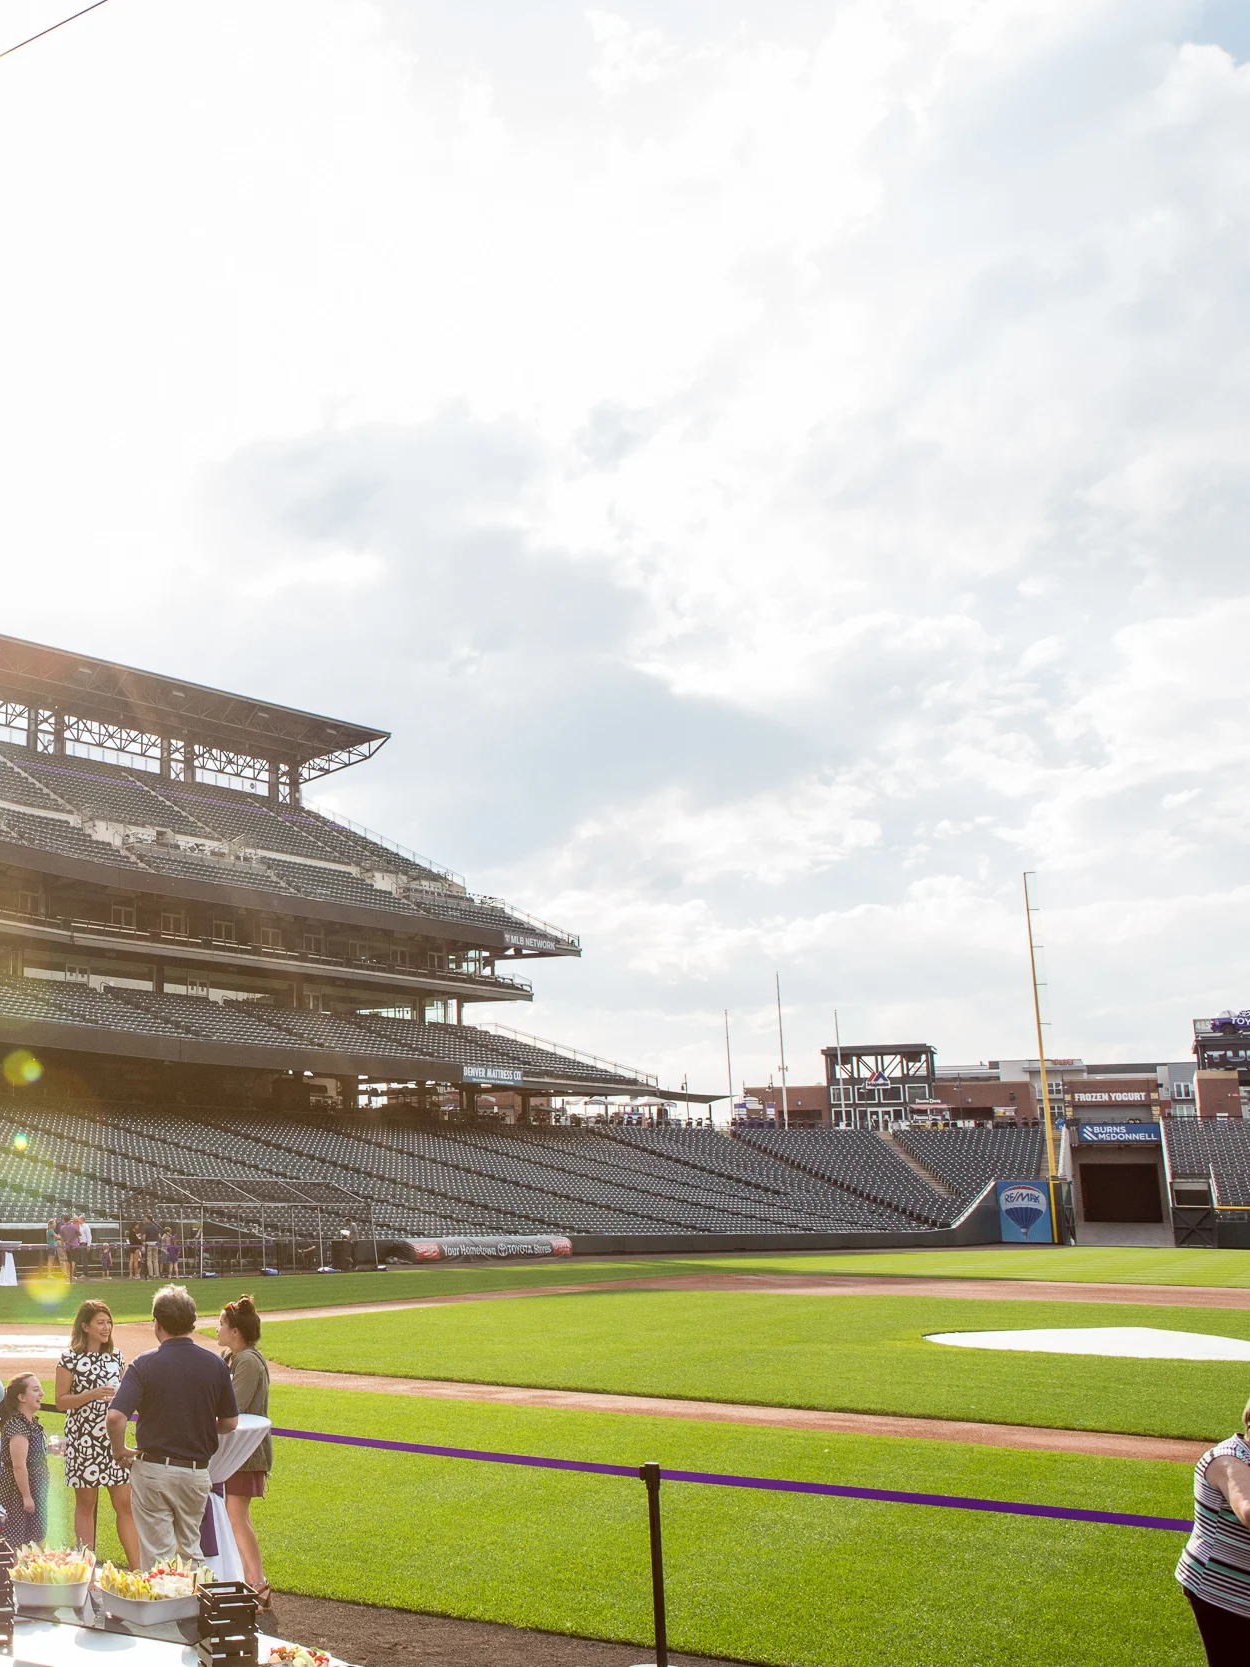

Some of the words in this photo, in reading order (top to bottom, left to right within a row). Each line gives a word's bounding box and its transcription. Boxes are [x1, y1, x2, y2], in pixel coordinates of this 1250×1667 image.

[511, 935, 525, 945] MLB
[525, 937, 556, 950] NETWORK
[463, 1066, 486, 1078] DENVER
[486, 1068, 513, 1080] MATTRESS
[1074, 1093, 1108, 1101] FROZEN
[1110, 1092, 1146, 1101] YOGURT
[1004, 1191, 1040, 1203] RE/MAX
[442, 1244, 459, 1256] Your
[460, 1245, 497, 1256] Hometown
[507, 1244, 533, 1254] TOYOTA
[533, 1244, 552, 1254] Stores
